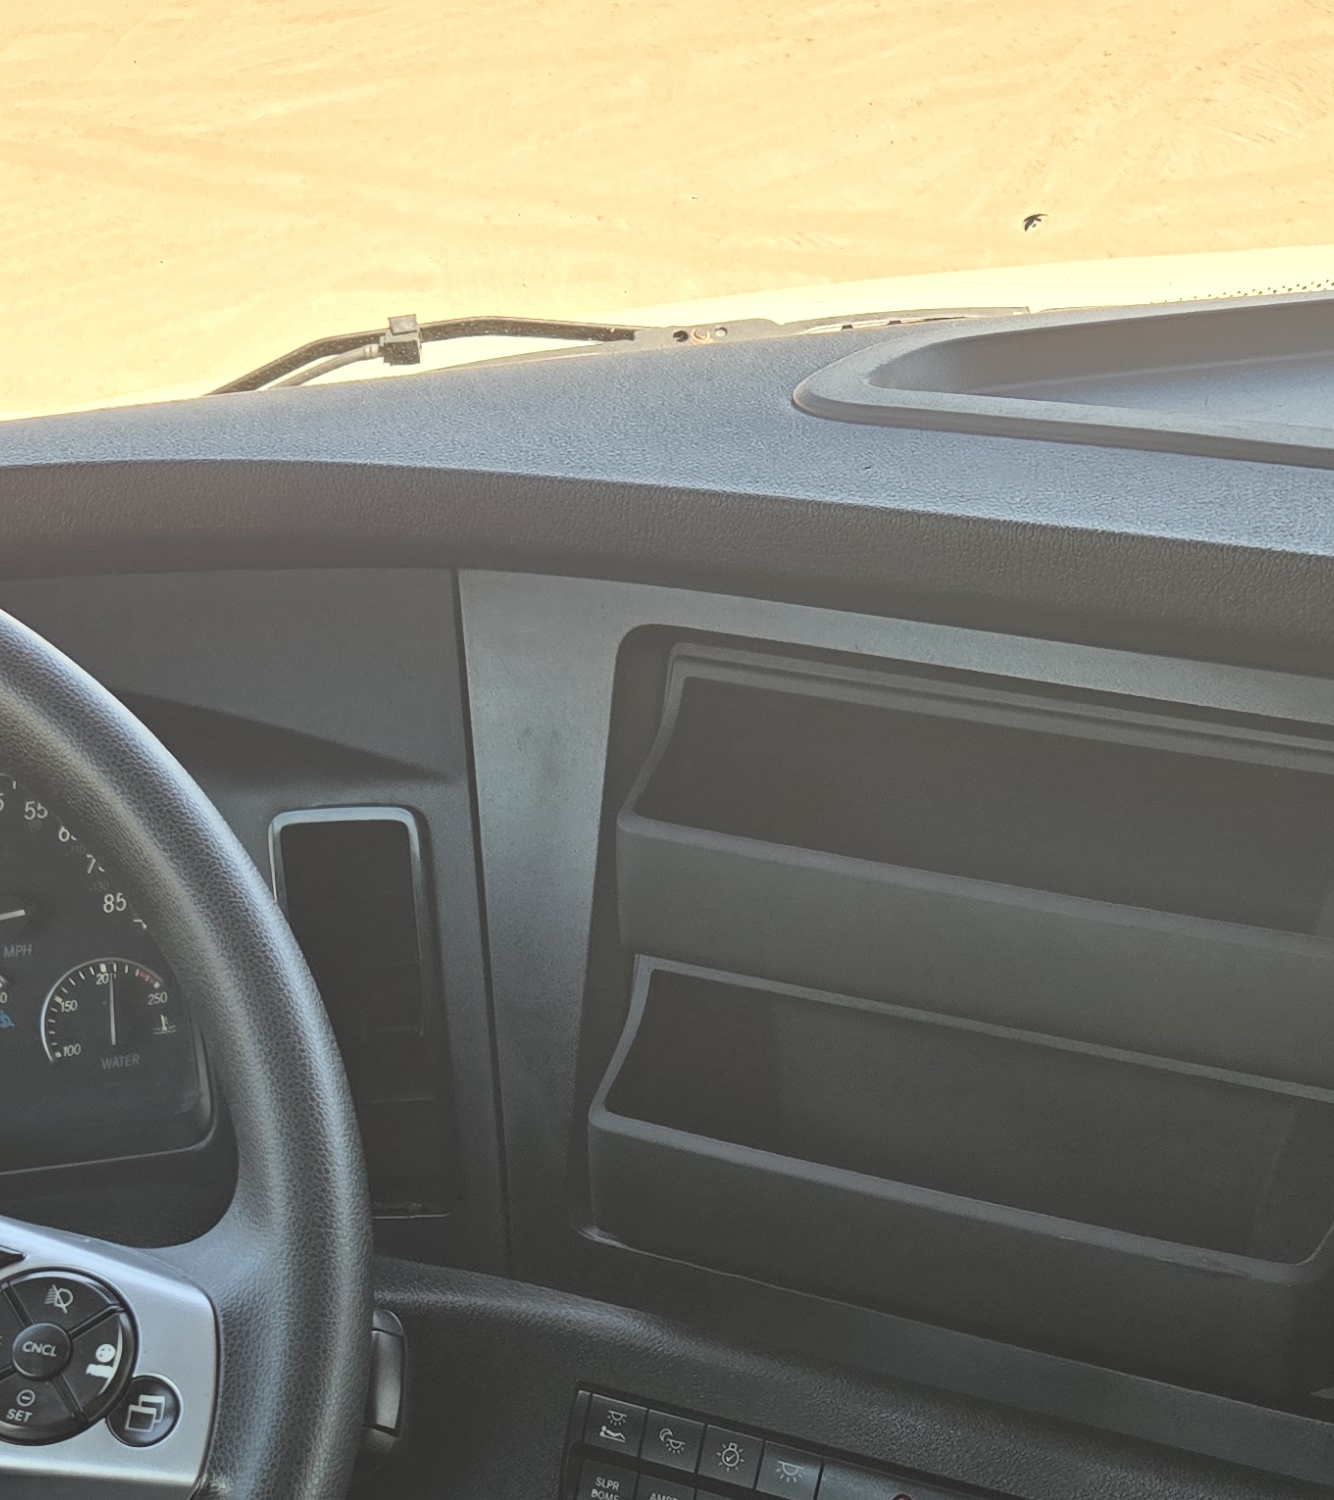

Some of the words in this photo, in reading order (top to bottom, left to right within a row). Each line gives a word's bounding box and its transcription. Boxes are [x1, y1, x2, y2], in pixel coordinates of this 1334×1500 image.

[24, 801, 48, 821] 55
[103, 892, 126, 913] 85
[3, 944, 32, 958] MPH
[148, 991, 168, 1005] 250
[60, 1000, 78, 1013] 150
[62, 1043, 81, 1057] 100
[100, 1054, 140, 1069] WATER
[22, 1342, 58, 1358] CNCL
[6, 1408, 33, 1423] SET
[595, 1476, 620, 1492] SLPR
